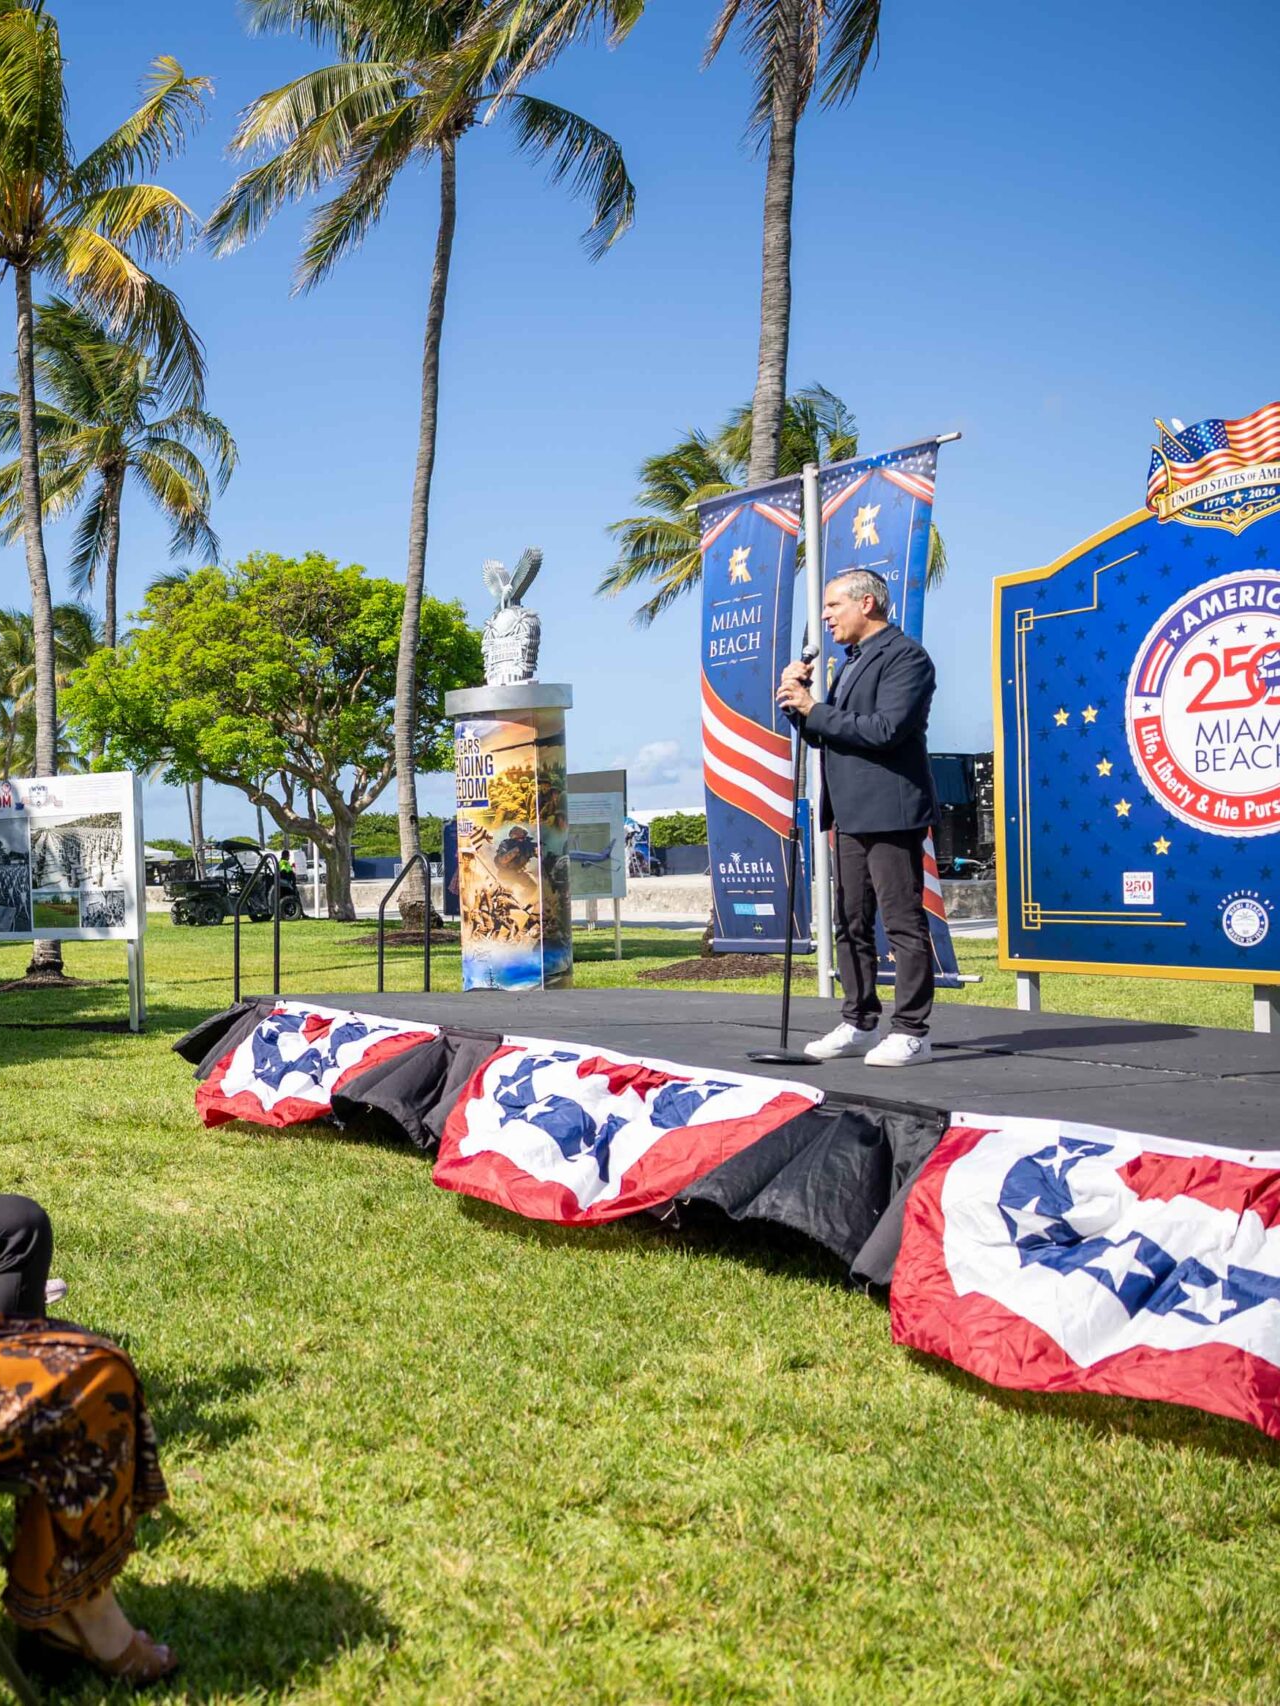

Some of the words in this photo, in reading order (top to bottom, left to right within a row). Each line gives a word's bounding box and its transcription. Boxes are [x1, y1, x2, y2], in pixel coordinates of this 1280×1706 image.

[1171, 484, 1208, 508] UNITED
[1209, 472, 1246, 492] STATES
[1247, 472, 1256, 481] OF
[1203, 497, 1226, 510] 1776
[1248, 487, 1276, 500] 2026
[711, 604, 762, 633] MIAMI
[709, 631, 761, 658] BEACH
[1140, 724, 1161, 760] Life,
[1152, 756, 1196, 808] Liberty
[1196, 794, 1210, 814] &
[1213, 798, 1240, 820] the
[719, 857, 774, 874] GALERÍA
[1125, 880, 1152, 892] 250
